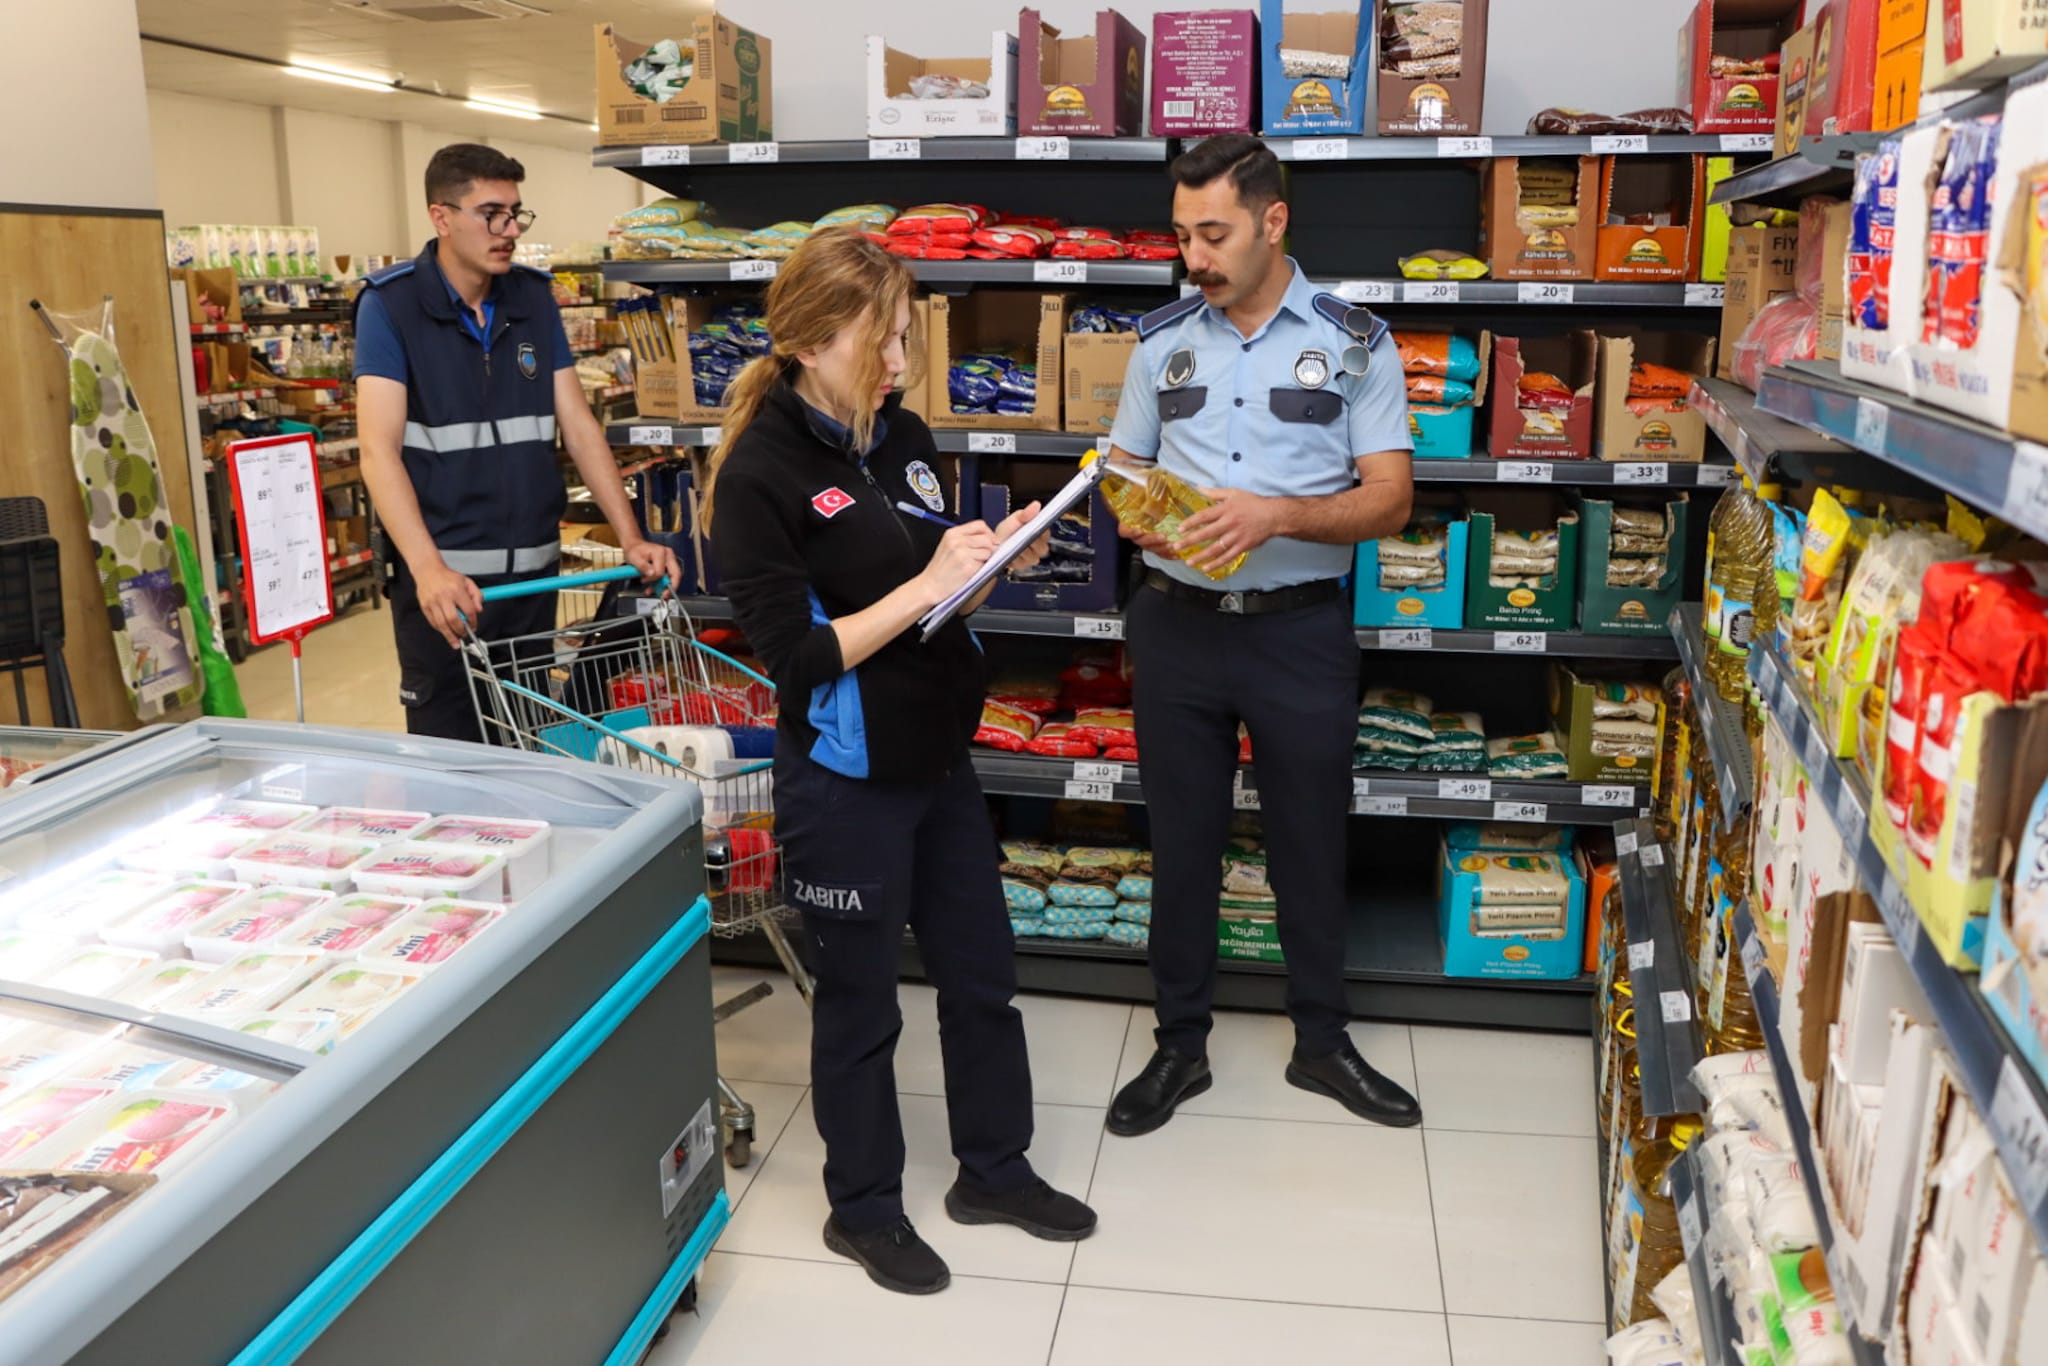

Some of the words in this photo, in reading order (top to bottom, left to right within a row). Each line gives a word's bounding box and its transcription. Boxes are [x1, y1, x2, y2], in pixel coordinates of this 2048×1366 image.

[895, 141, 909, 152] 21
[1042, 141, 1058, 152] 19
[1463, 141, 1480, 151] 51
[1615, 138, 1632, 148] 79
[1750, 137, 1767, 146] 15
[754, 145, 768, 156] 13
[1316, 142, 1333, 154] 65
[666, 150, 681, 160] 22
[751, 263, 765, 273] 10
[1060, 265, 1076, 276] 10
[1365, 285, 1382, 297] 23
[1431, 285, 1447, 297] 20
[1542, 286, 1558, 297] 20
[649, 430, 662, 439] 20
[990, 437, 1005, 447] 20
[1526, 466, 1542, 476] 32
[1637, 466, 1653, 477] 33
[1096, 622, 1112, 632] 15
[1405, 631, 1420, 642] 41
[1516, 635, 1532, 645] 62
[1095, 766, 1110, 776] 10
[1086, 783, 1100, 794] 21
[1461, 784, 1476, 794] 49
[1604, 790, 1620, 800] 97
[1520, 806, 1536, 817] 64
[793, 878, 863, 911] ZABITA
[218, 918, 256, 938] vini
[1229, 924, 1264, 938] Yayla
[308, 926, 344, 947] vini
[392, 935, 427, 958] vini
[102, 1064, 141, 1082] ini
[72, 1146, 118, 1171] ini
